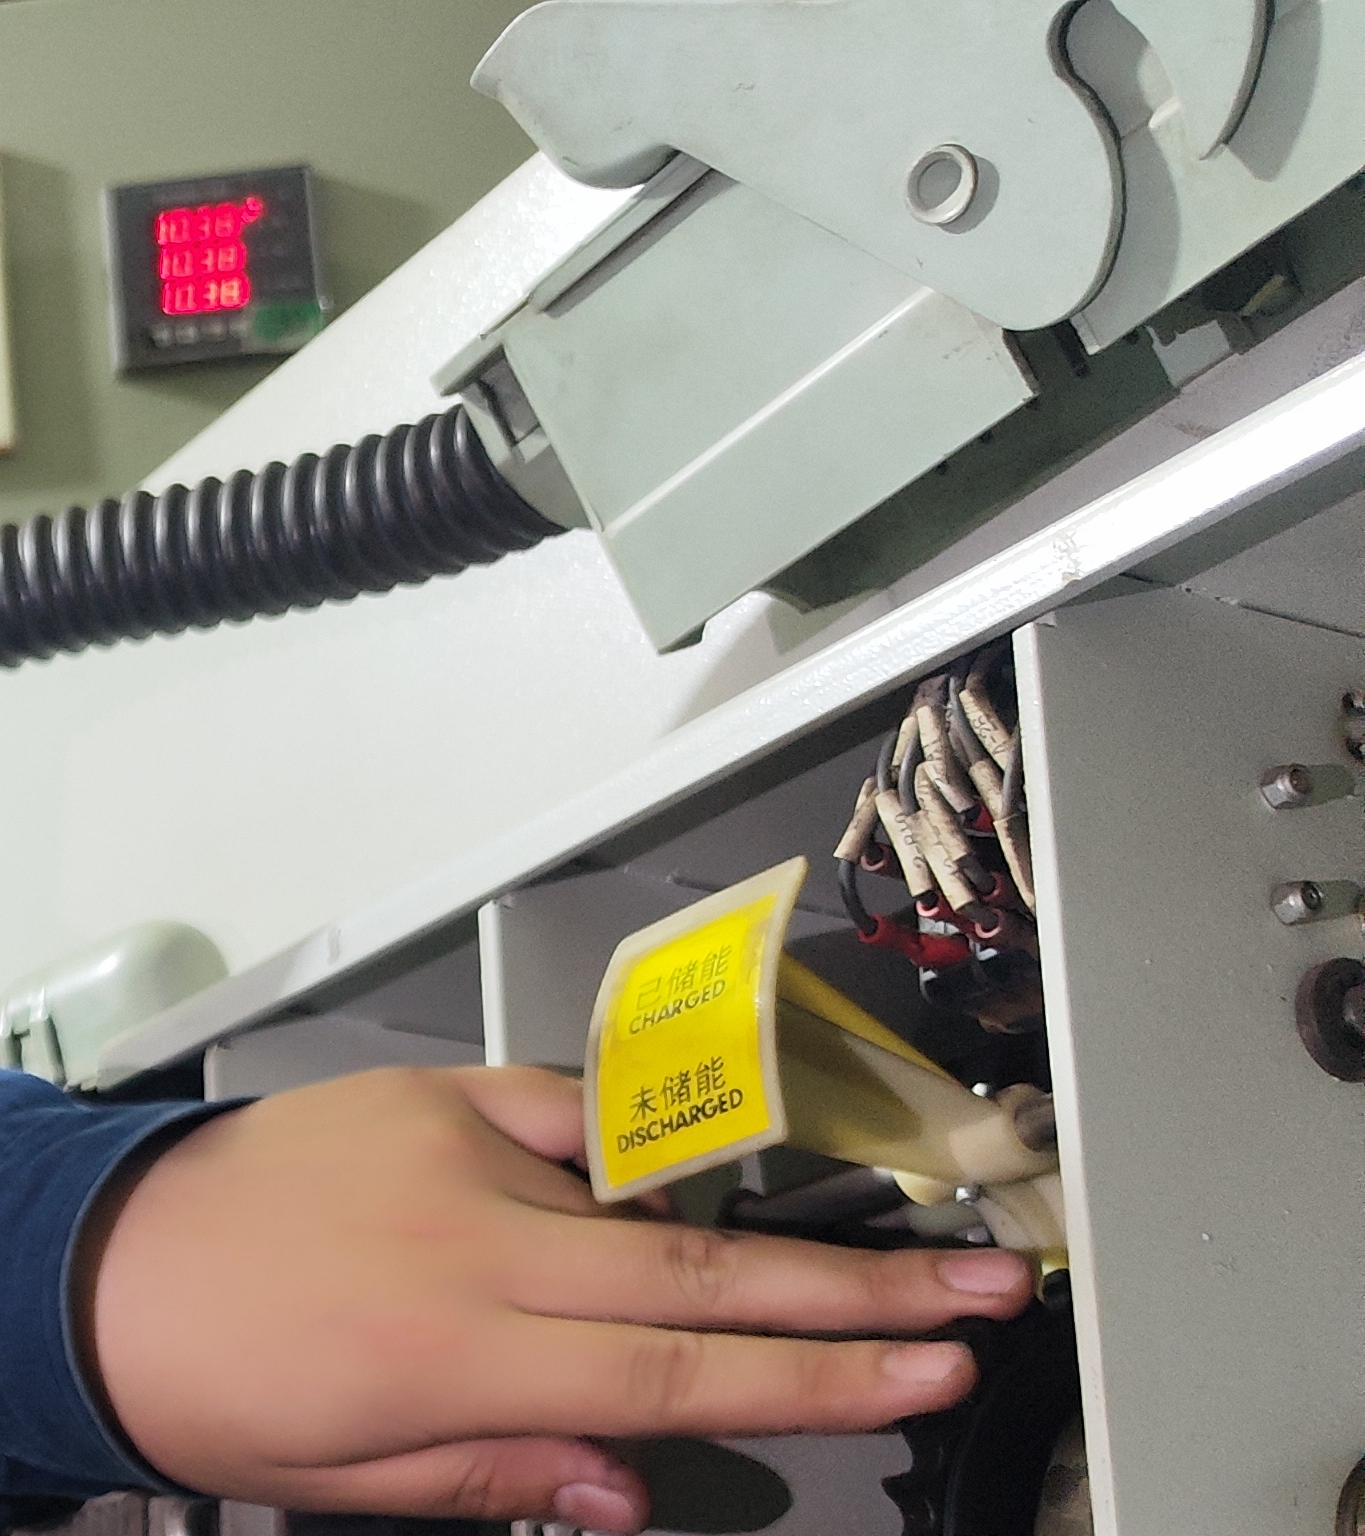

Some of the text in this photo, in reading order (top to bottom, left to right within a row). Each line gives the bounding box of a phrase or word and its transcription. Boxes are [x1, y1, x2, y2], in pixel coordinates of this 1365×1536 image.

[628, 979, 726, 1035] CHARGED
[635, 945, 732, 1012] 已储能
[616, 1088, 744, 1154] DISCHARGED
[628, 1056, 727, 1123] 未储能
